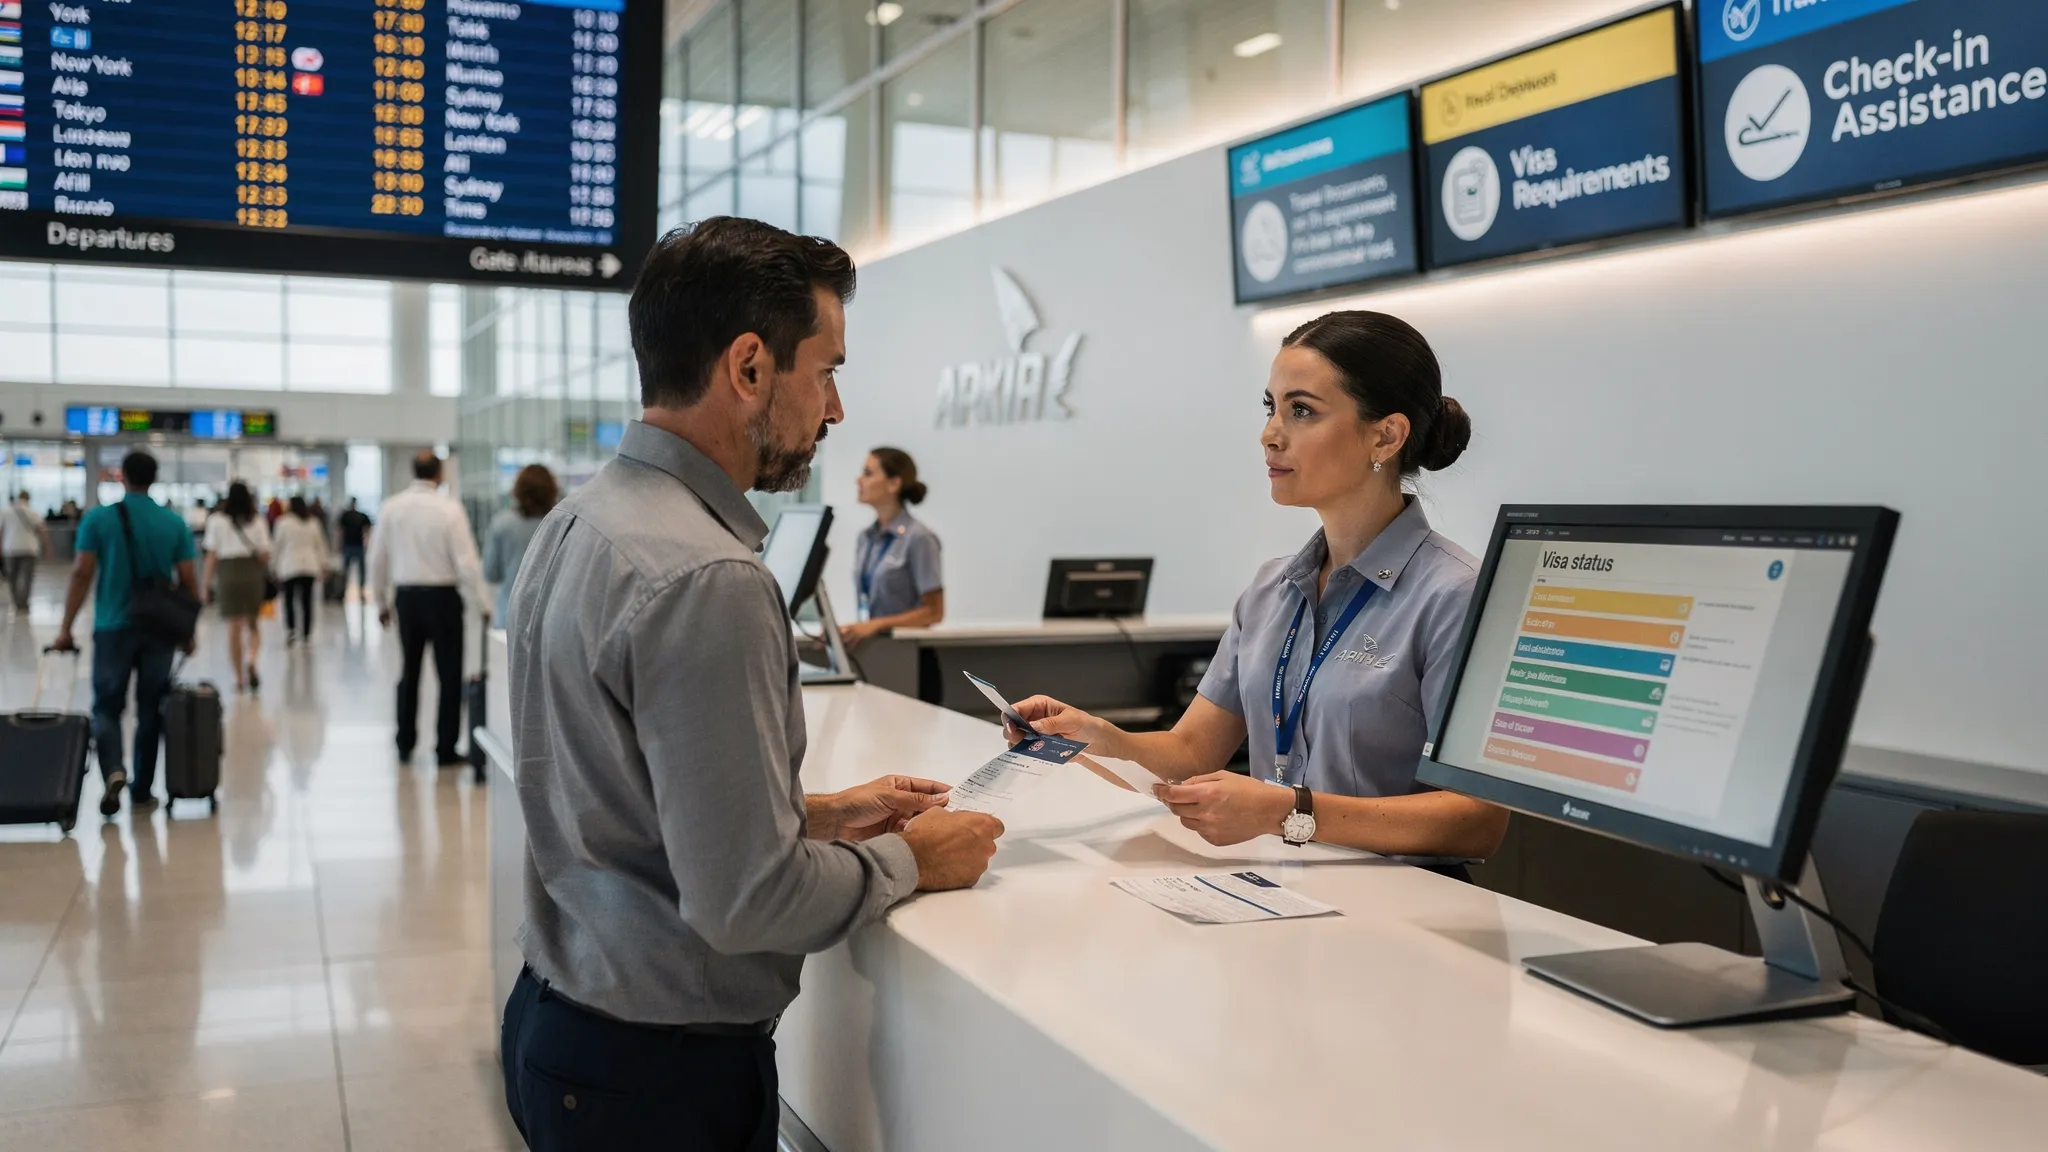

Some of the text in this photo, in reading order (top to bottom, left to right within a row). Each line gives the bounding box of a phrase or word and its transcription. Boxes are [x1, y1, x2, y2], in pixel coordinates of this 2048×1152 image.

[51, 51, 92, 73] New
[1823, 28, 1990, 101] Check-in
[52, 99, 106, 125] Tokyo
[1831, 65, 2048, 143] Assistance
[1511, 152, 1673, 211] Requirements
[47, 221, 176, 252] Departures
[1541, 550, 1614, 572] Visa status
